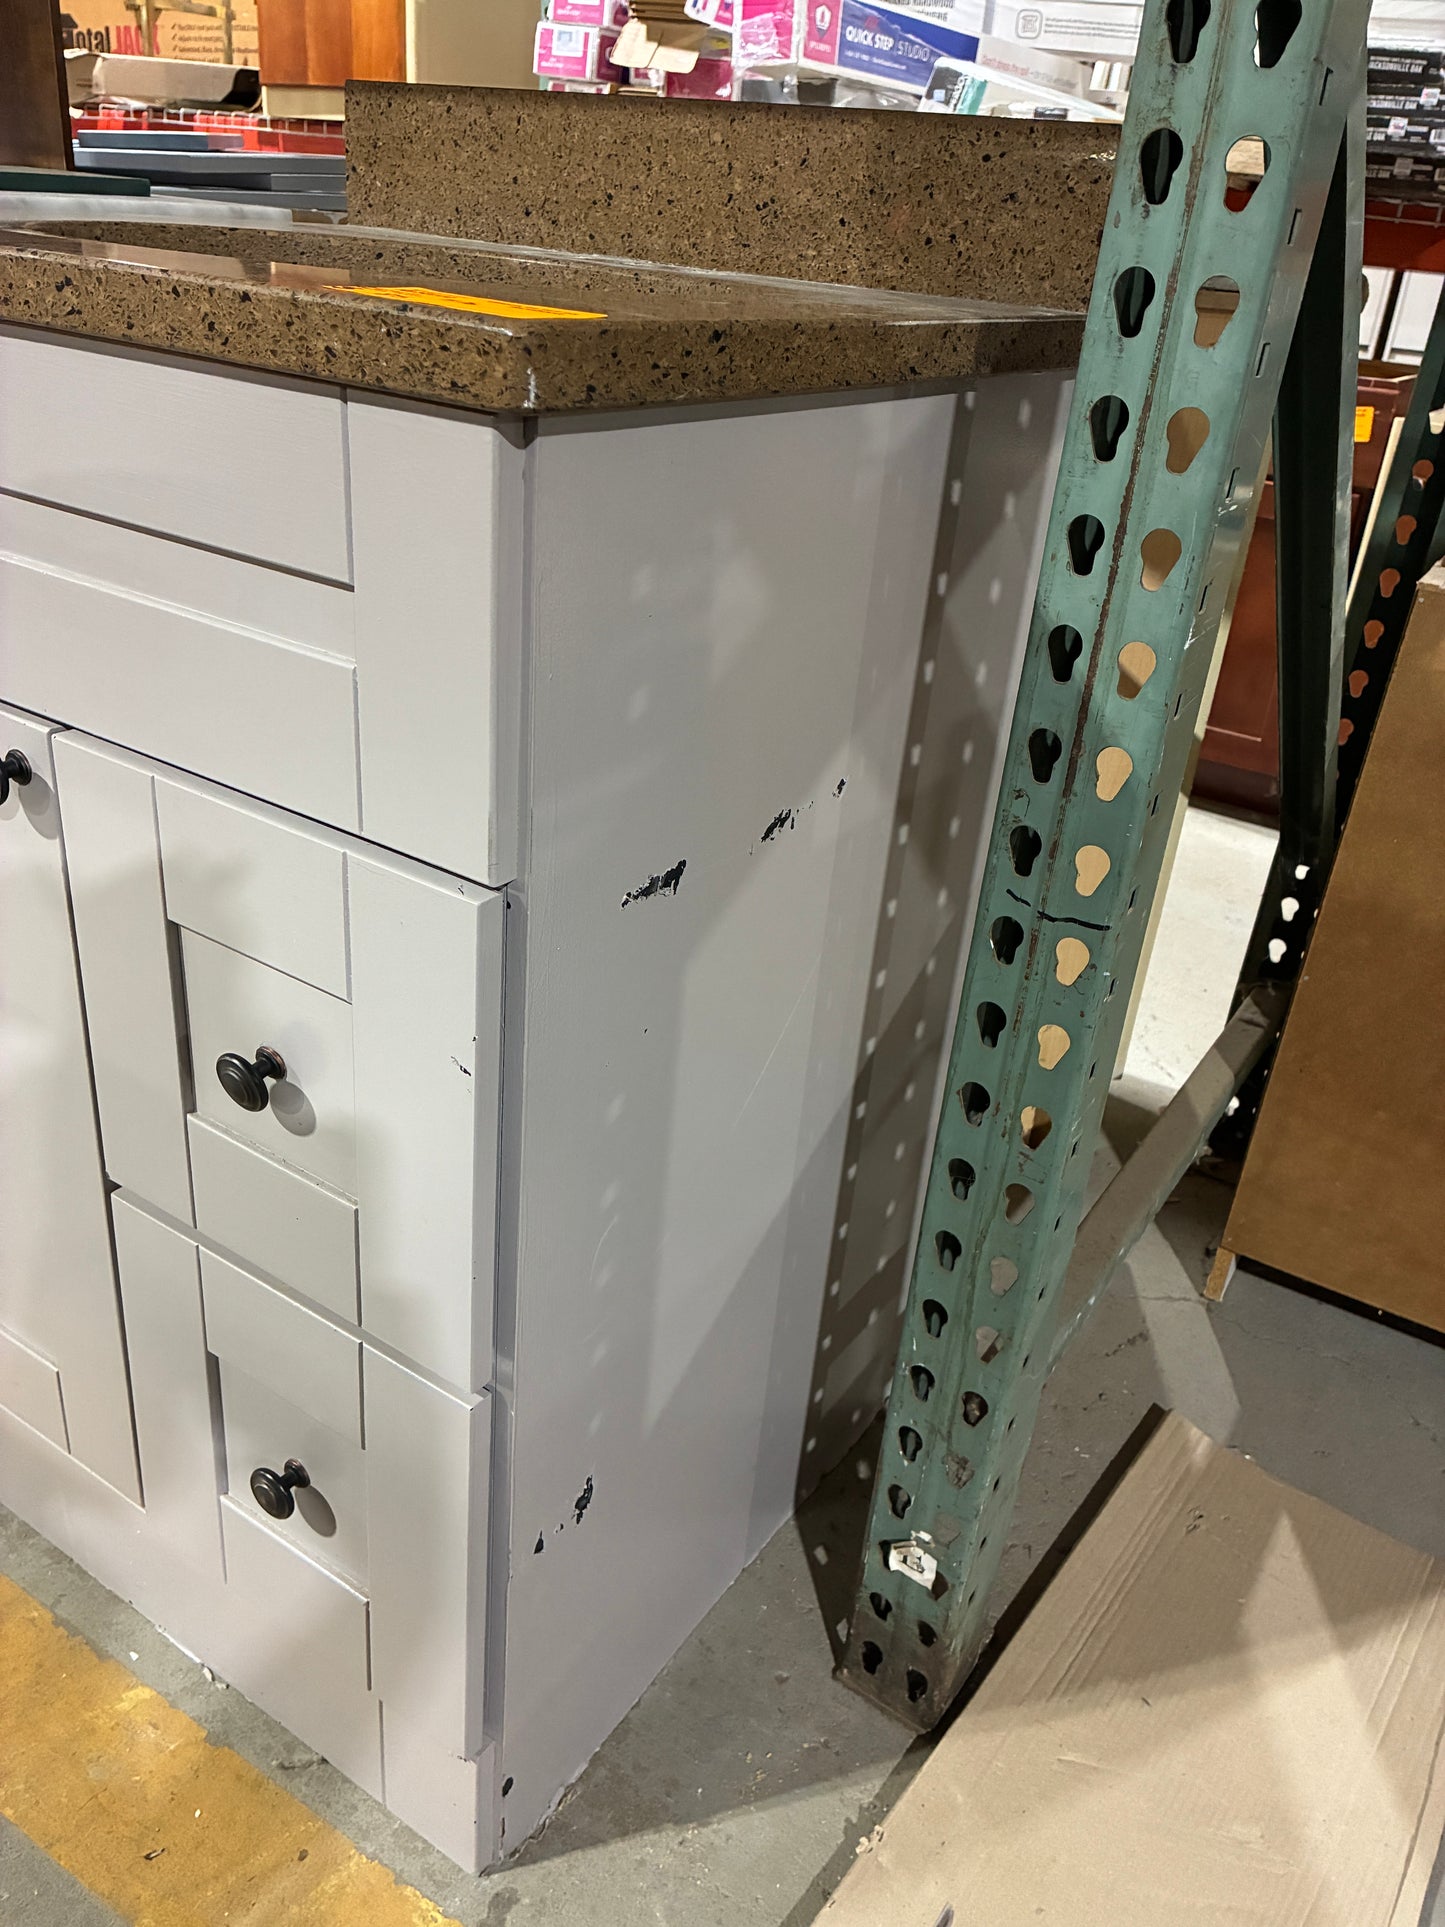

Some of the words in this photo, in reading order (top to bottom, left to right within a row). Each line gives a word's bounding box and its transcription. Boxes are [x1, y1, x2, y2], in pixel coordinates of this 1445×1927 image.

[845, 25, 874, 47] QUICK
[873, 33, 895, 51] STEP
[897, 40, 930, 62] STUDIO
